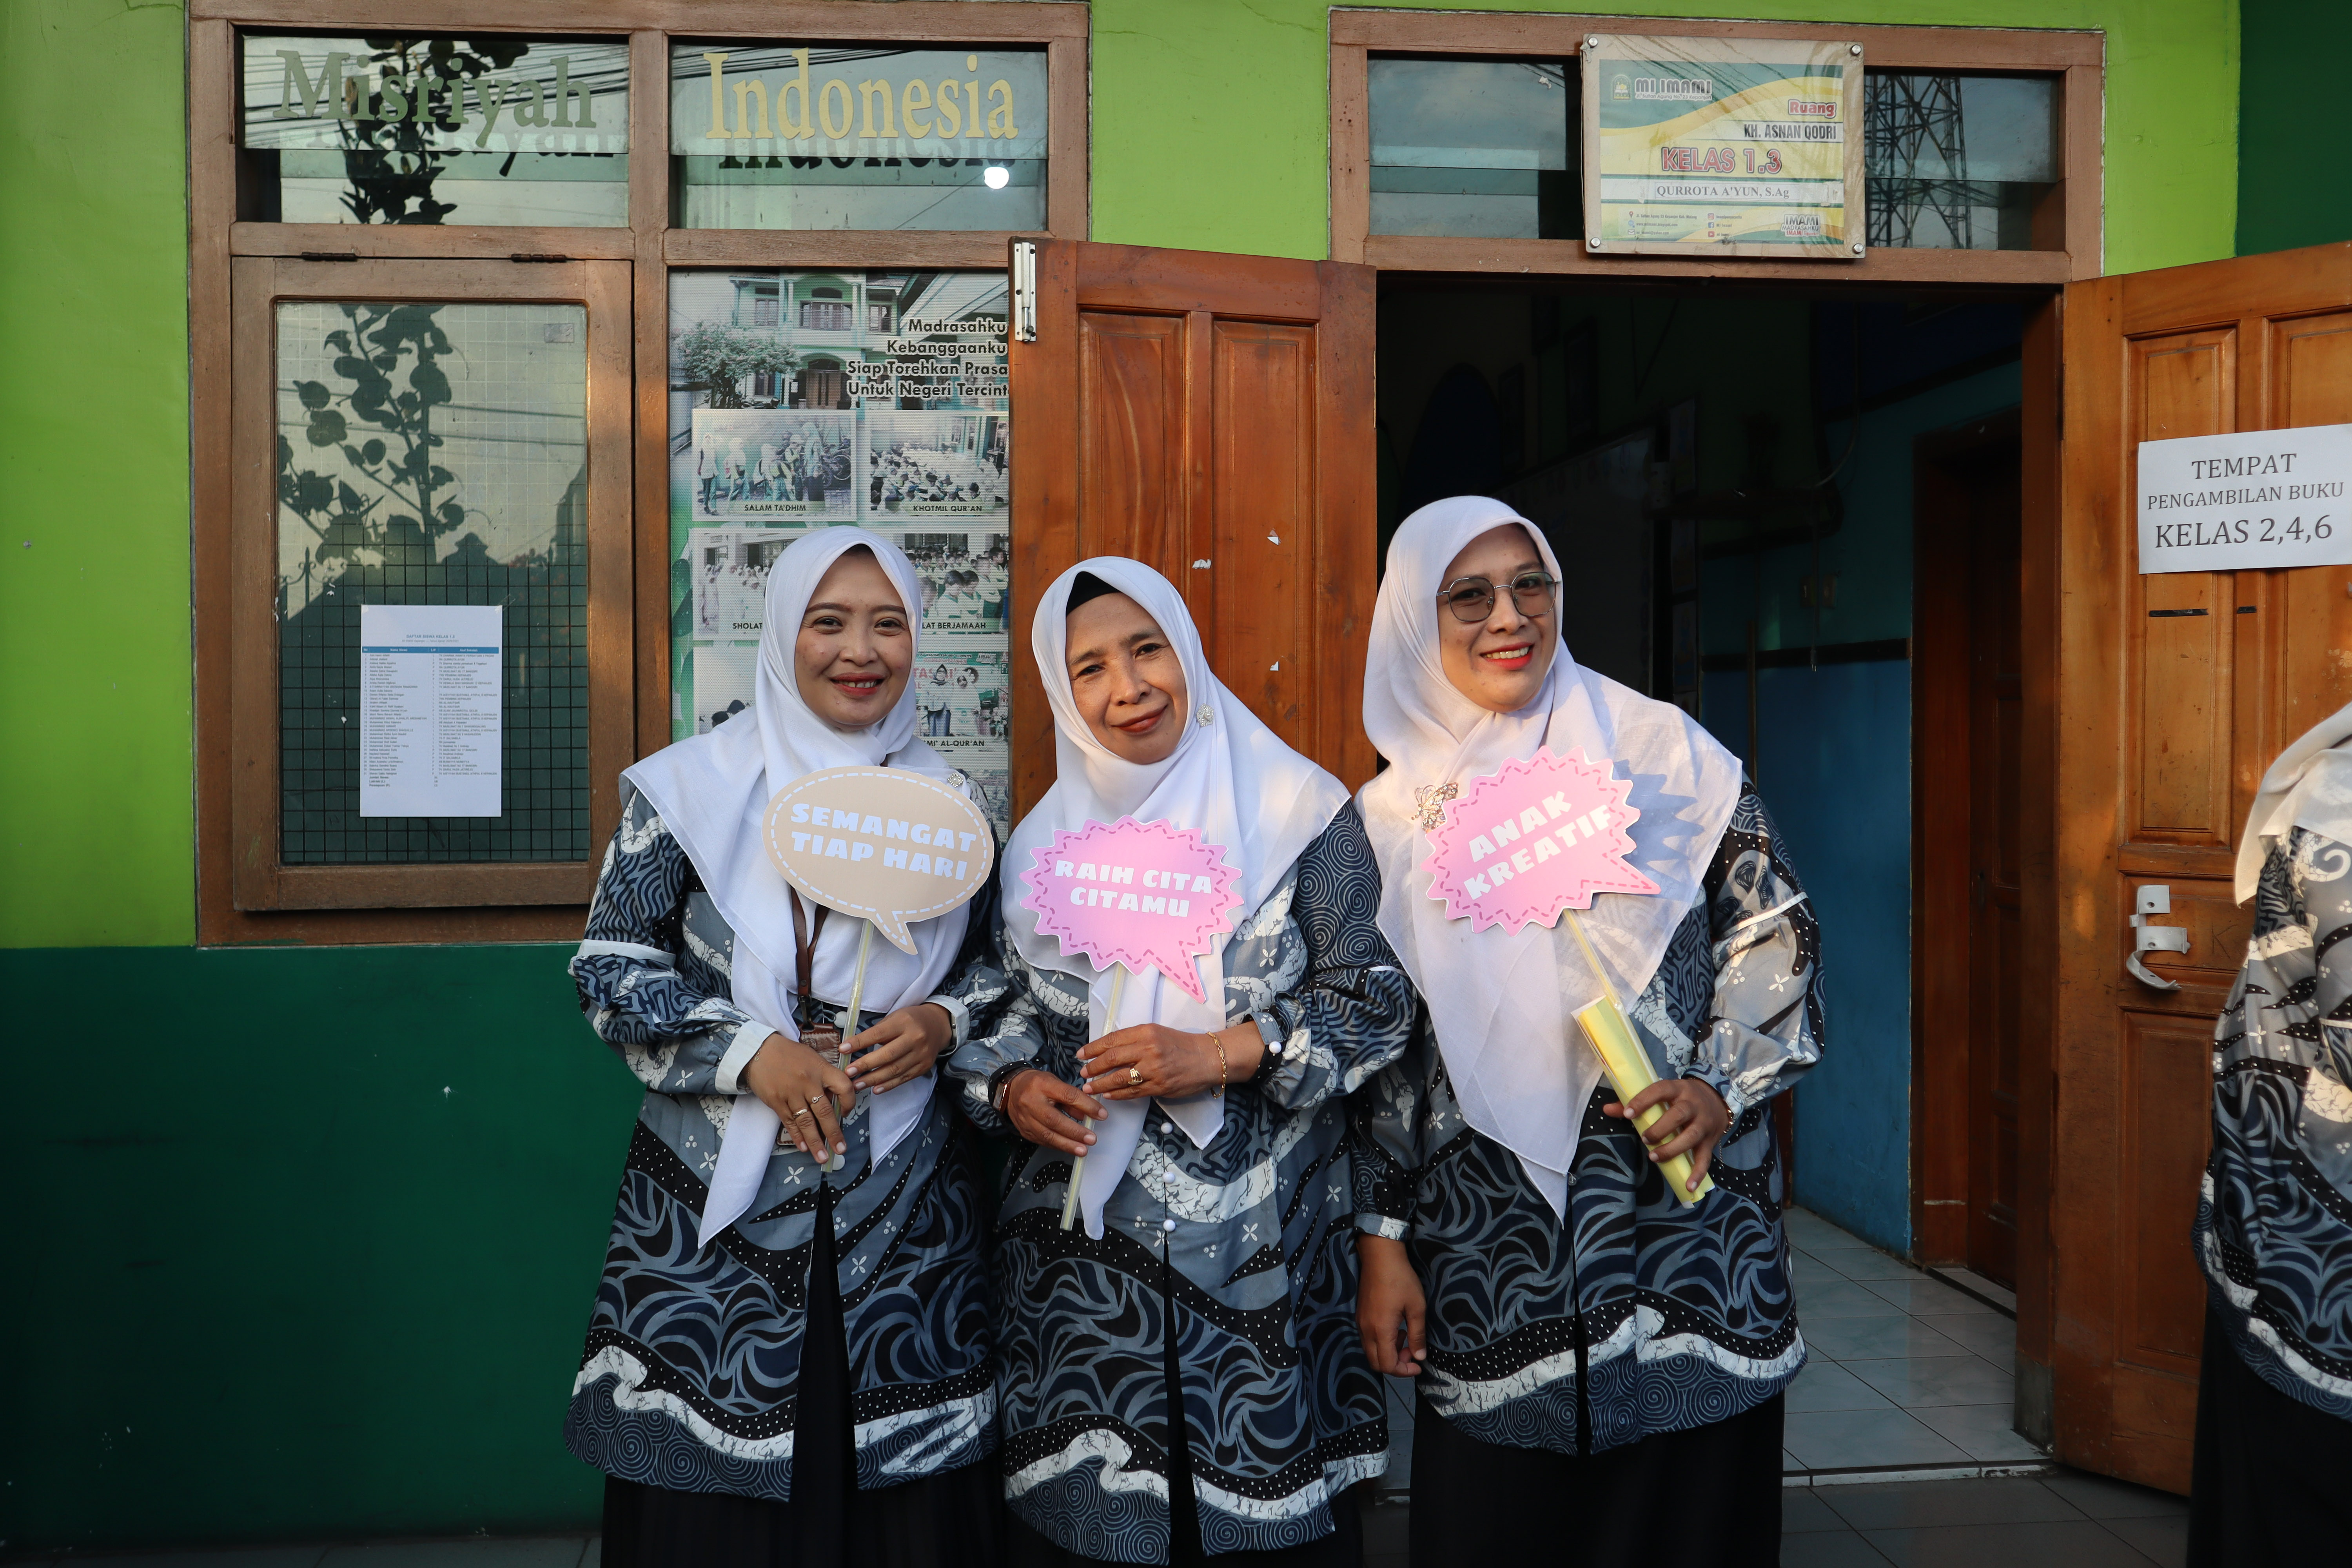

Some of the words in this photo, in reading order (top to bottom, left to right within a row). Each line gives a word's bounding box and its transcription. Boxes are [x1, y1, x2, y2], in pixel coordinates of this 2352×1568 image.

[272, 50, 597, 147] Misriyah
[703, 47, 1018, 140] Indonesia
[1636, 79, 1655, 93] MI
[1661, 80, 1711, 93] IMAMI
[1789, 101, 1835, 117] Ruang
[1744, 124, 1762, 139] KH.
[1764, 123, 1801, 139] ASNAN
[1804, 124, 1837, 140] QODRI
[1662, 147, 1735, 172] KELAS
[1744, 149, 1782, 174] 1.3
[1657, 186, 1718, 196] QURROTA
[1721, 187, 1762, 197] A'YUN,
[1765, 187, 1789, 198] S.Ag
[1786, 216, 1819, 225] IMAMI
[908, 319, 1006, 332] Madrasahku
[887, 340, 1006, 356] Kebanggaanku
[848, 361, 882, 377] Siap
[887, 361, 958, 374] Torehkan
[849, 382, 894, 395] Untuk
[900, 382, 951, 398] Negeri
[957, 383, 1009, 396] Tercint
[2191, 453, 2297, 479] TEMPAT
[2147, 486, 2282, 510] PENGAMBILAN
[2288, 482, 2345, 500] BUKU
[2155, 519, 2249, 548] KELAS
[2259, 514, 2332, 545] 2,4,6
[791, 803, 977, 852] SEMANGAT
[1468, 790, 1572, 863] ANAK
[791, 831, 874, 862] TIAP
[883, 847, 967, 881] HARI
[1463, 804, 1613, 900] KREATIF
[1054, 860, 1135, 885] RAIH
[1142, 869, 1212, 894] CITA
[1070, 886, 1190, 918] CITAMU
